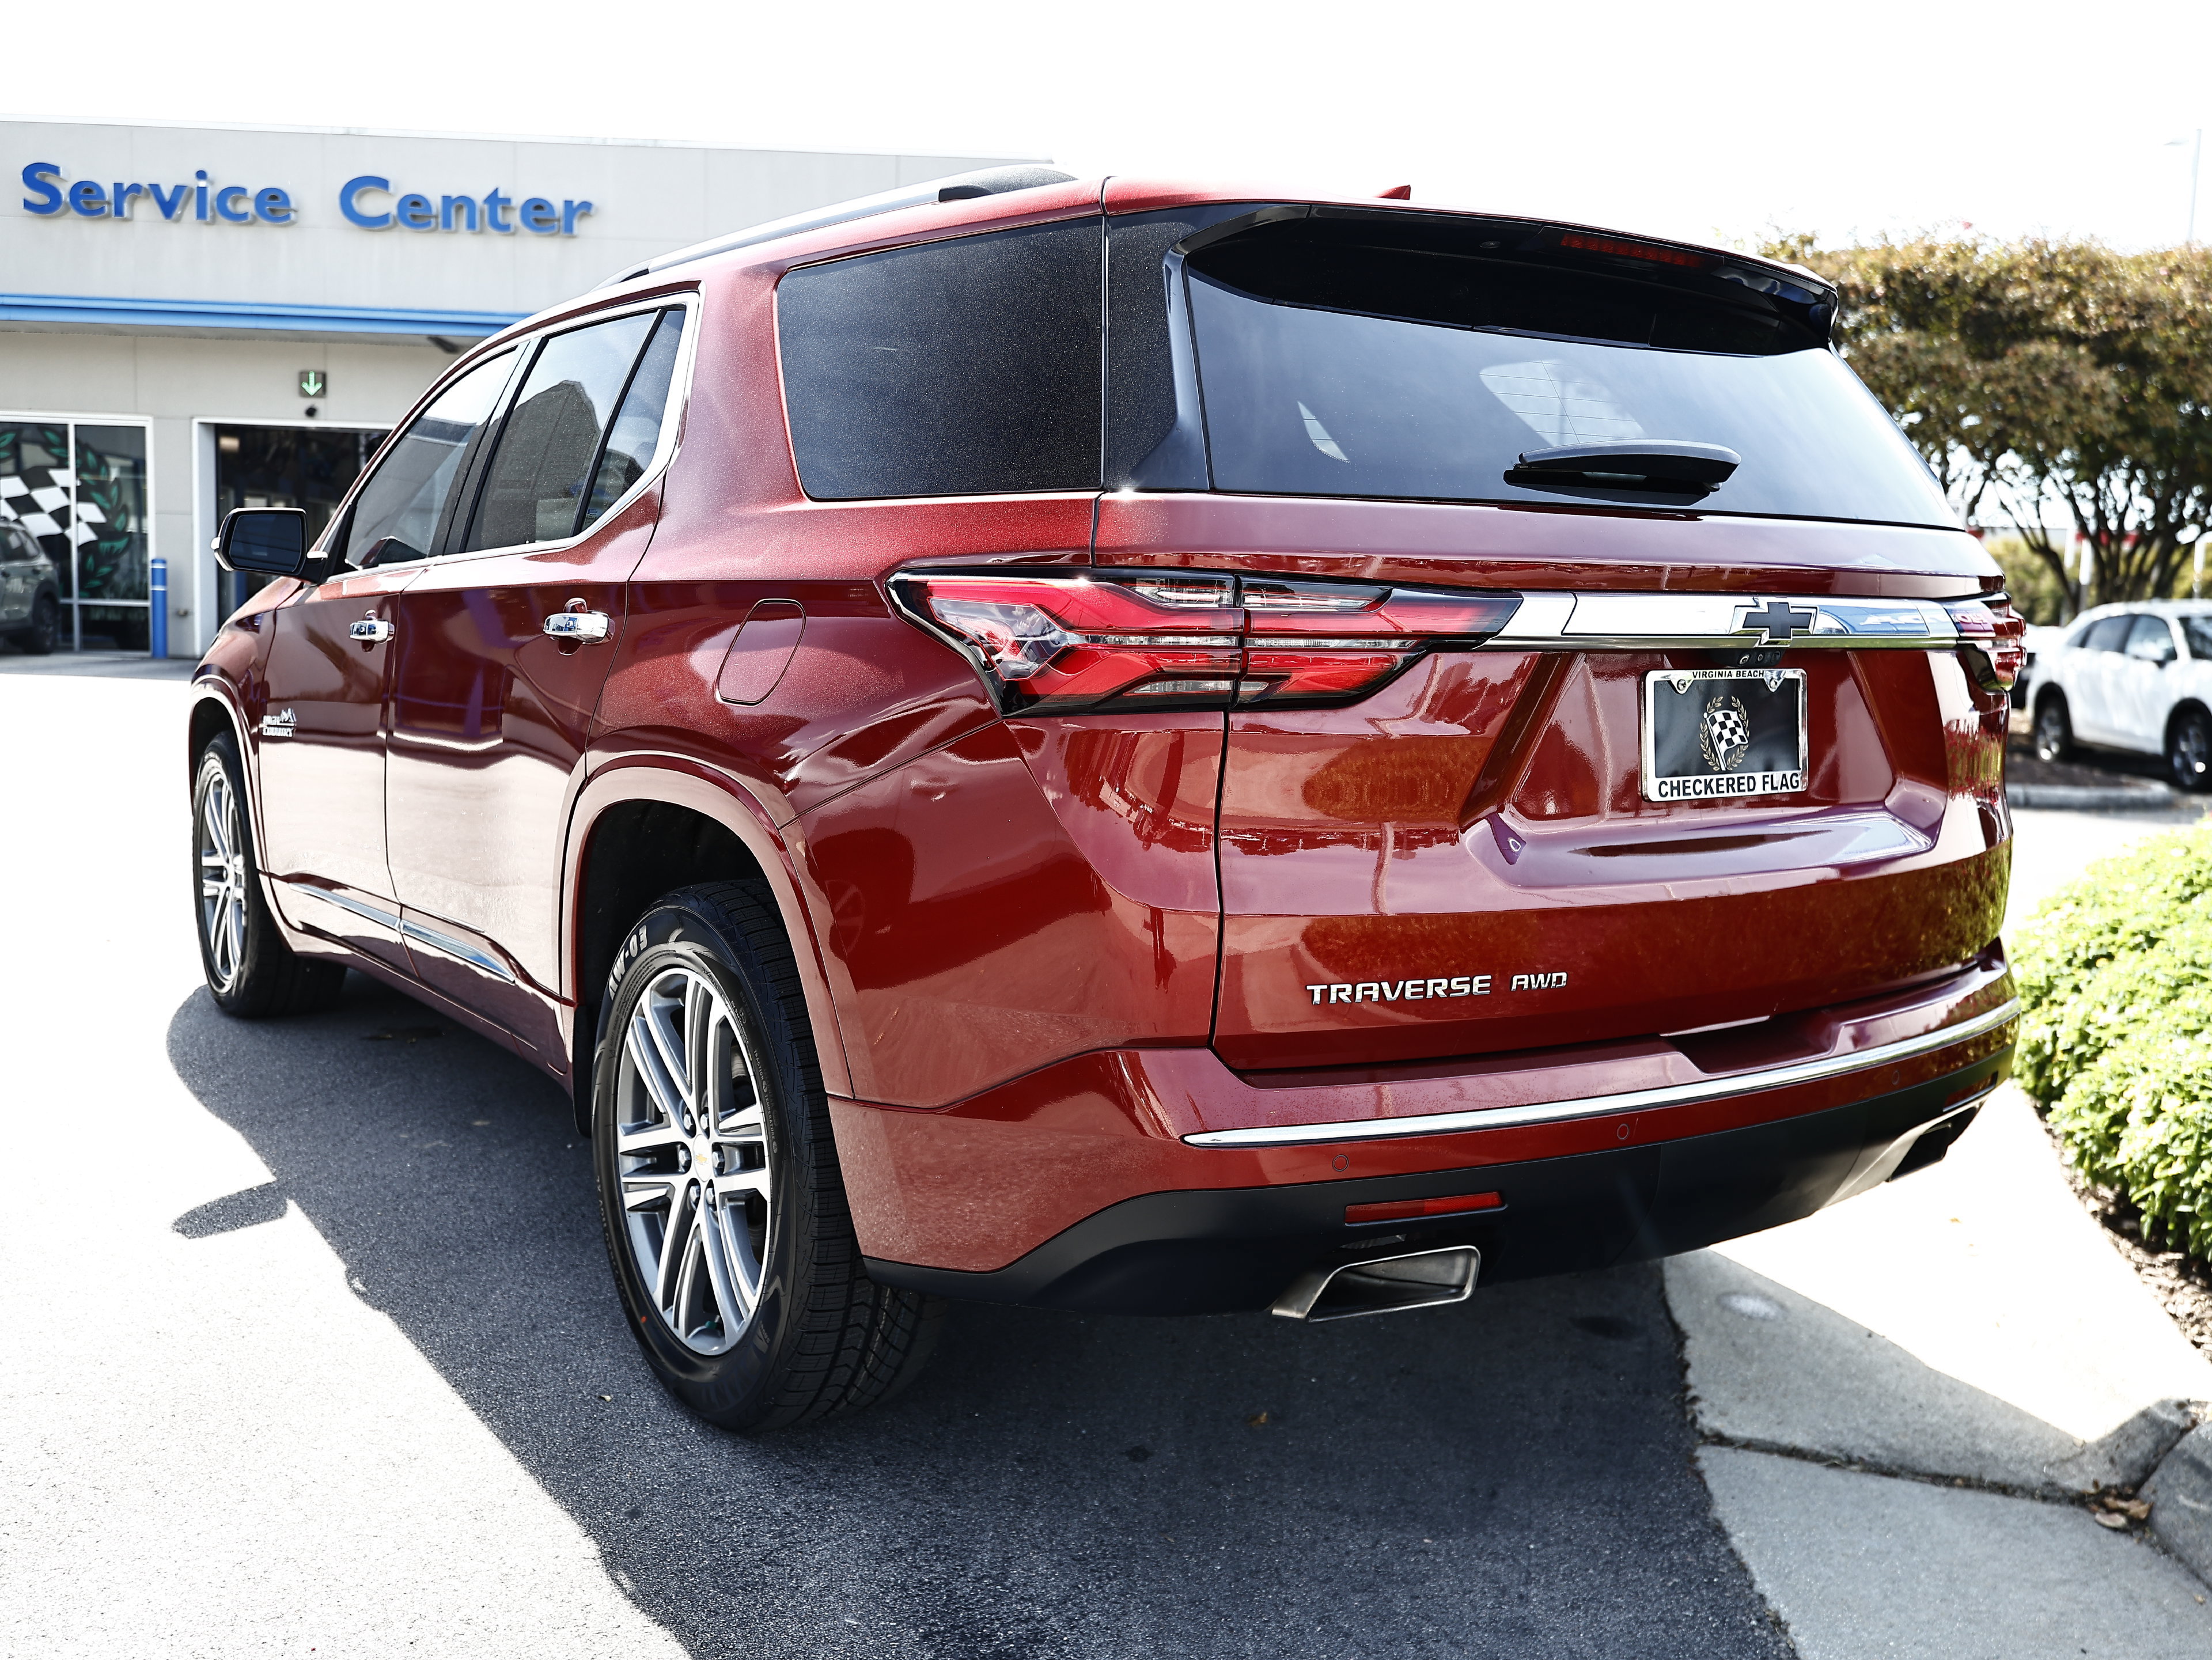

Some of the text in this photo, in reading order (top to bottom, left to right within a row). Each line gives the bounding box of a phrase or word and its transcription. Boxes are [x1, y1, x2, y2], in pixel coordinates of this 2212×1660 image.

[21, 161, 593, 237] Service Center
[1692, 670, 1764, 679] VIRGINIA BEACH
[1658, 772, 1800, 798] CHECKERED FLAG
[1306, 972, 1568, 1005] TRAVERSE AWD
[753, 1049, 764, 1081] TRACTION
[764, 1094, 775, 1139] TEMPERATURE
